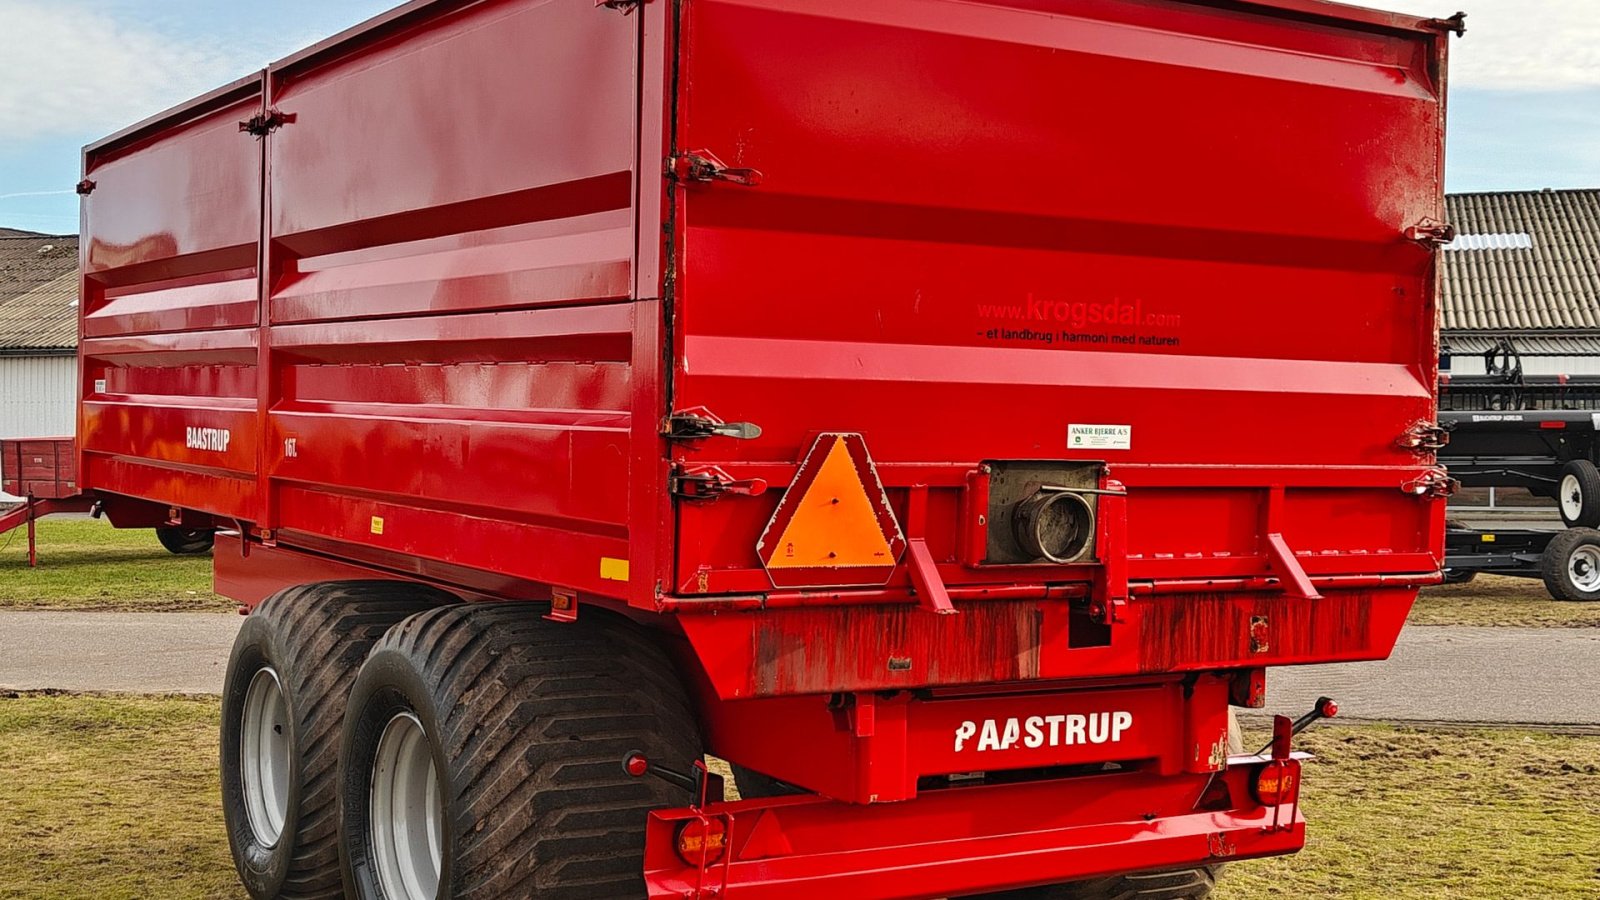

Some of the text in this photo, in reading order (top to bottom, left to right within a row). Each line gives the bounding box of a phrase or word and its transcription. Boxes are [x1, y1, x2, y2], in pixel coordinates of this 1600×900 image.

[977, 292, 1181, 328] www.krogsdal.com
[986, 328, 998, 340] et
[1001, 328, 1052, 344] landbrug
[1062, 330, 1108, 343] harmoni
[1111, 332, 1136, 344] med
[1138, 335, 1180, 346] naturen
[186, 426, 230, 452] BAASTRUP
[1071, 427, 1094, 435] ANKER
